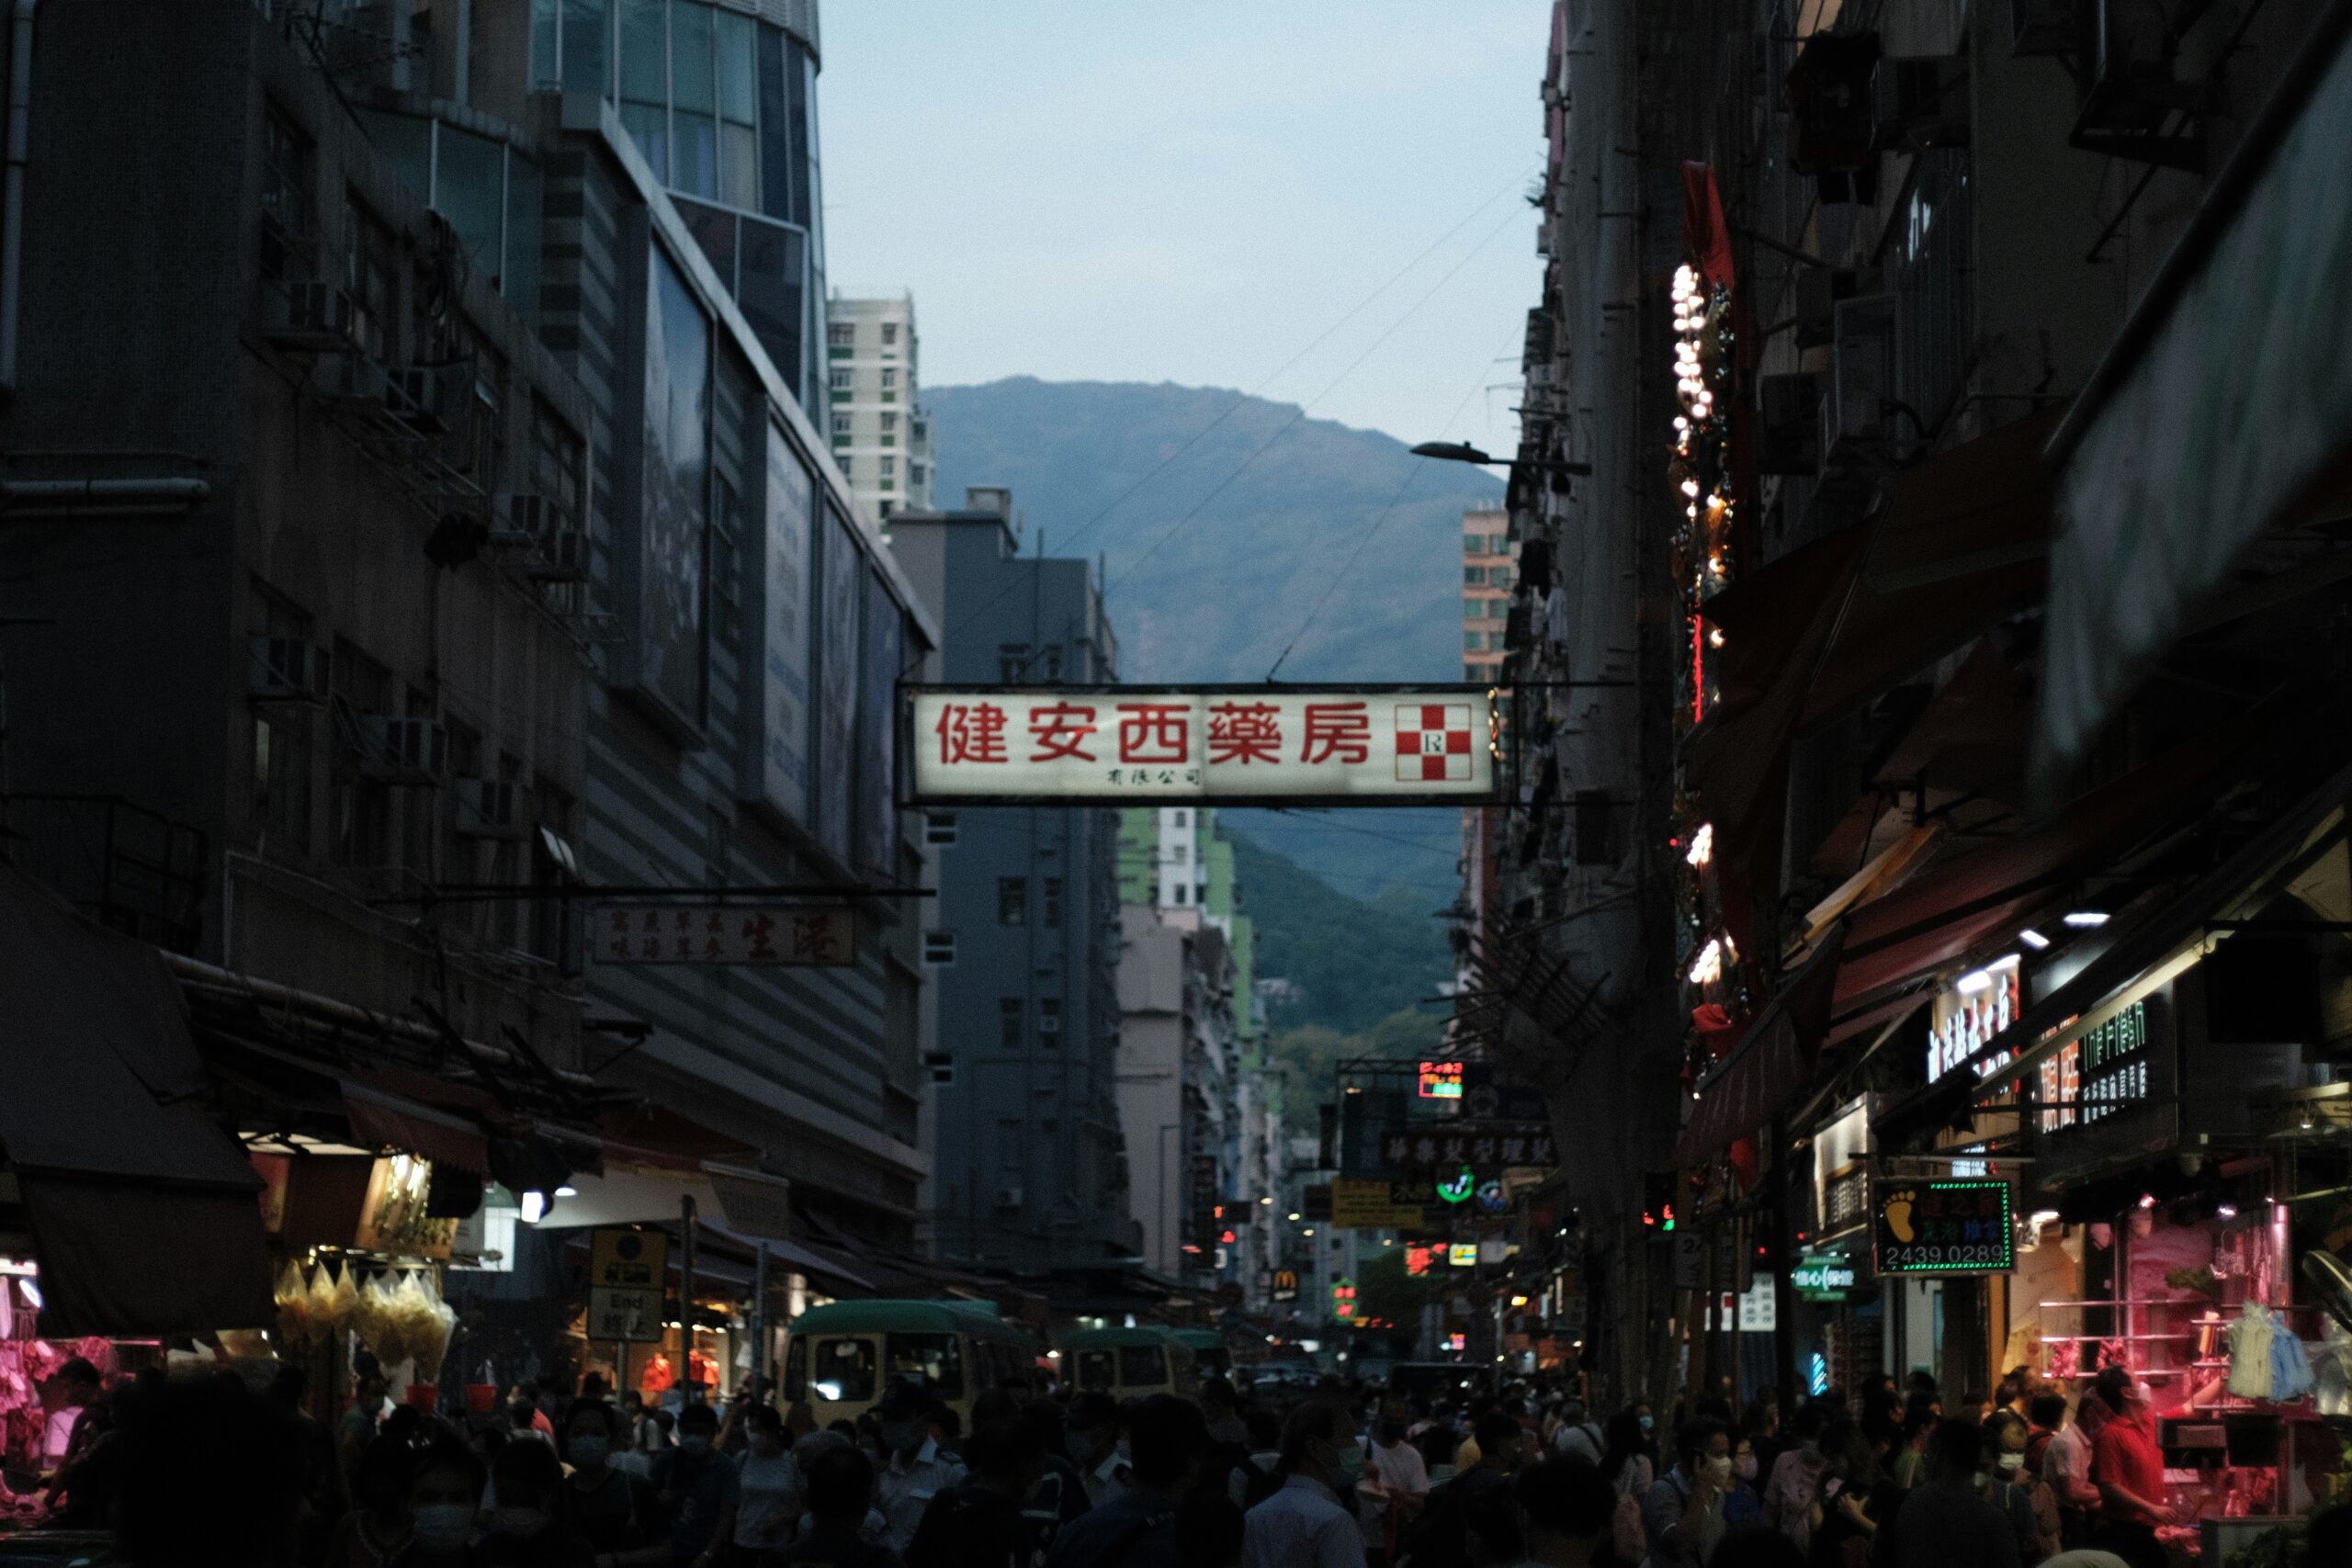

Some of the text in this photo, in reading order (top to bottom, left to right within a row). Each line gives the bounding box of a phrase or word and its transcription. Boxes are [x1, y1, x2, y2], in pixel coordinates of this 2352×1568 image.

[935, 702, 1372, 764] 健安西藥房
[1108, 769, 1200, 785] 有限公司
[1886, 1245, 2003, 1265] 2439 0289
[611, 1294, 644, 1309] End
